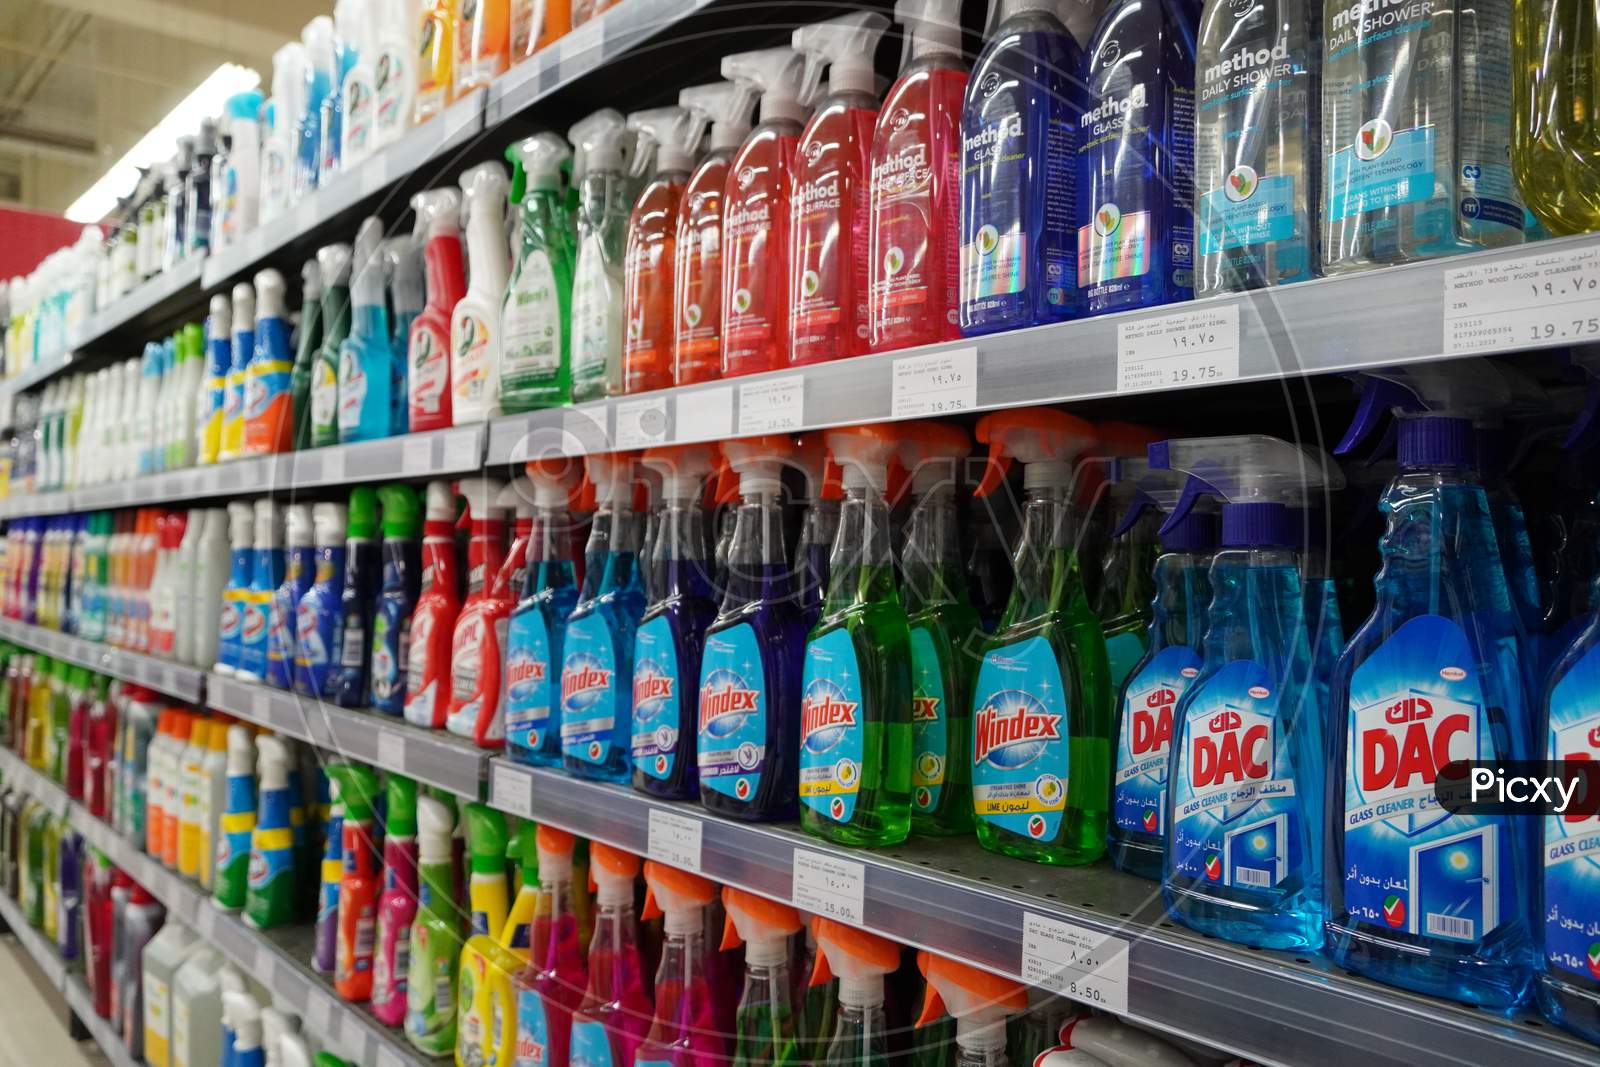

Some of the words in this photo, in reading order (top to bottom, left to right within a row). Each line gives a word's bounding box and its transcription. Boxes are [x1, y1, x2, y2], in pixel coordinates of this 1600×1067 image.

[1329, 22, 1361, 50] DAILY
[1362, 1, 1431, 33] SHOWER
[1202, 79, 1231, 100] DAILY
[1233, 63, 1292, 87] SHOWER
[1093, 116, 1125, 136] GLASS
[1513, 270, 1540, 281] FLOOR
[1544, 264, 1583, 276] CLEANER
[1530, 318, 1600, 341] 19.75
[1172, 366, 1216, 382] 19.75
[931, 399, 962, 412] 19.75
[1208, 711, 1242, 734] داك
[1385, 697, 1434, 725] داك
[975, 704, 1062, 765] Windex
[1132, 705, 1173, 755] DA
[1192, 724, 1269, 788] DAC
[1363, 713, 1470, 792] DAC
[1140, 757, 1164, 772] CLEANER
[986, 802, 1000, 812] LIME
[1002, 800, 1030, 813] ليمون
[1183, 800, 1200, 815] GLASS
[1201, 792, 1228, 808] CLEANER
[1349, 808, 1374, 826] GLASS
[1375, 799, 1415, 817] CLEANER
[1549, 842, 1576, 860] GLASS
[1362, 906, 1380, 919] ٦٥٠
[1070, 982, 1100, 1001] 8.50
